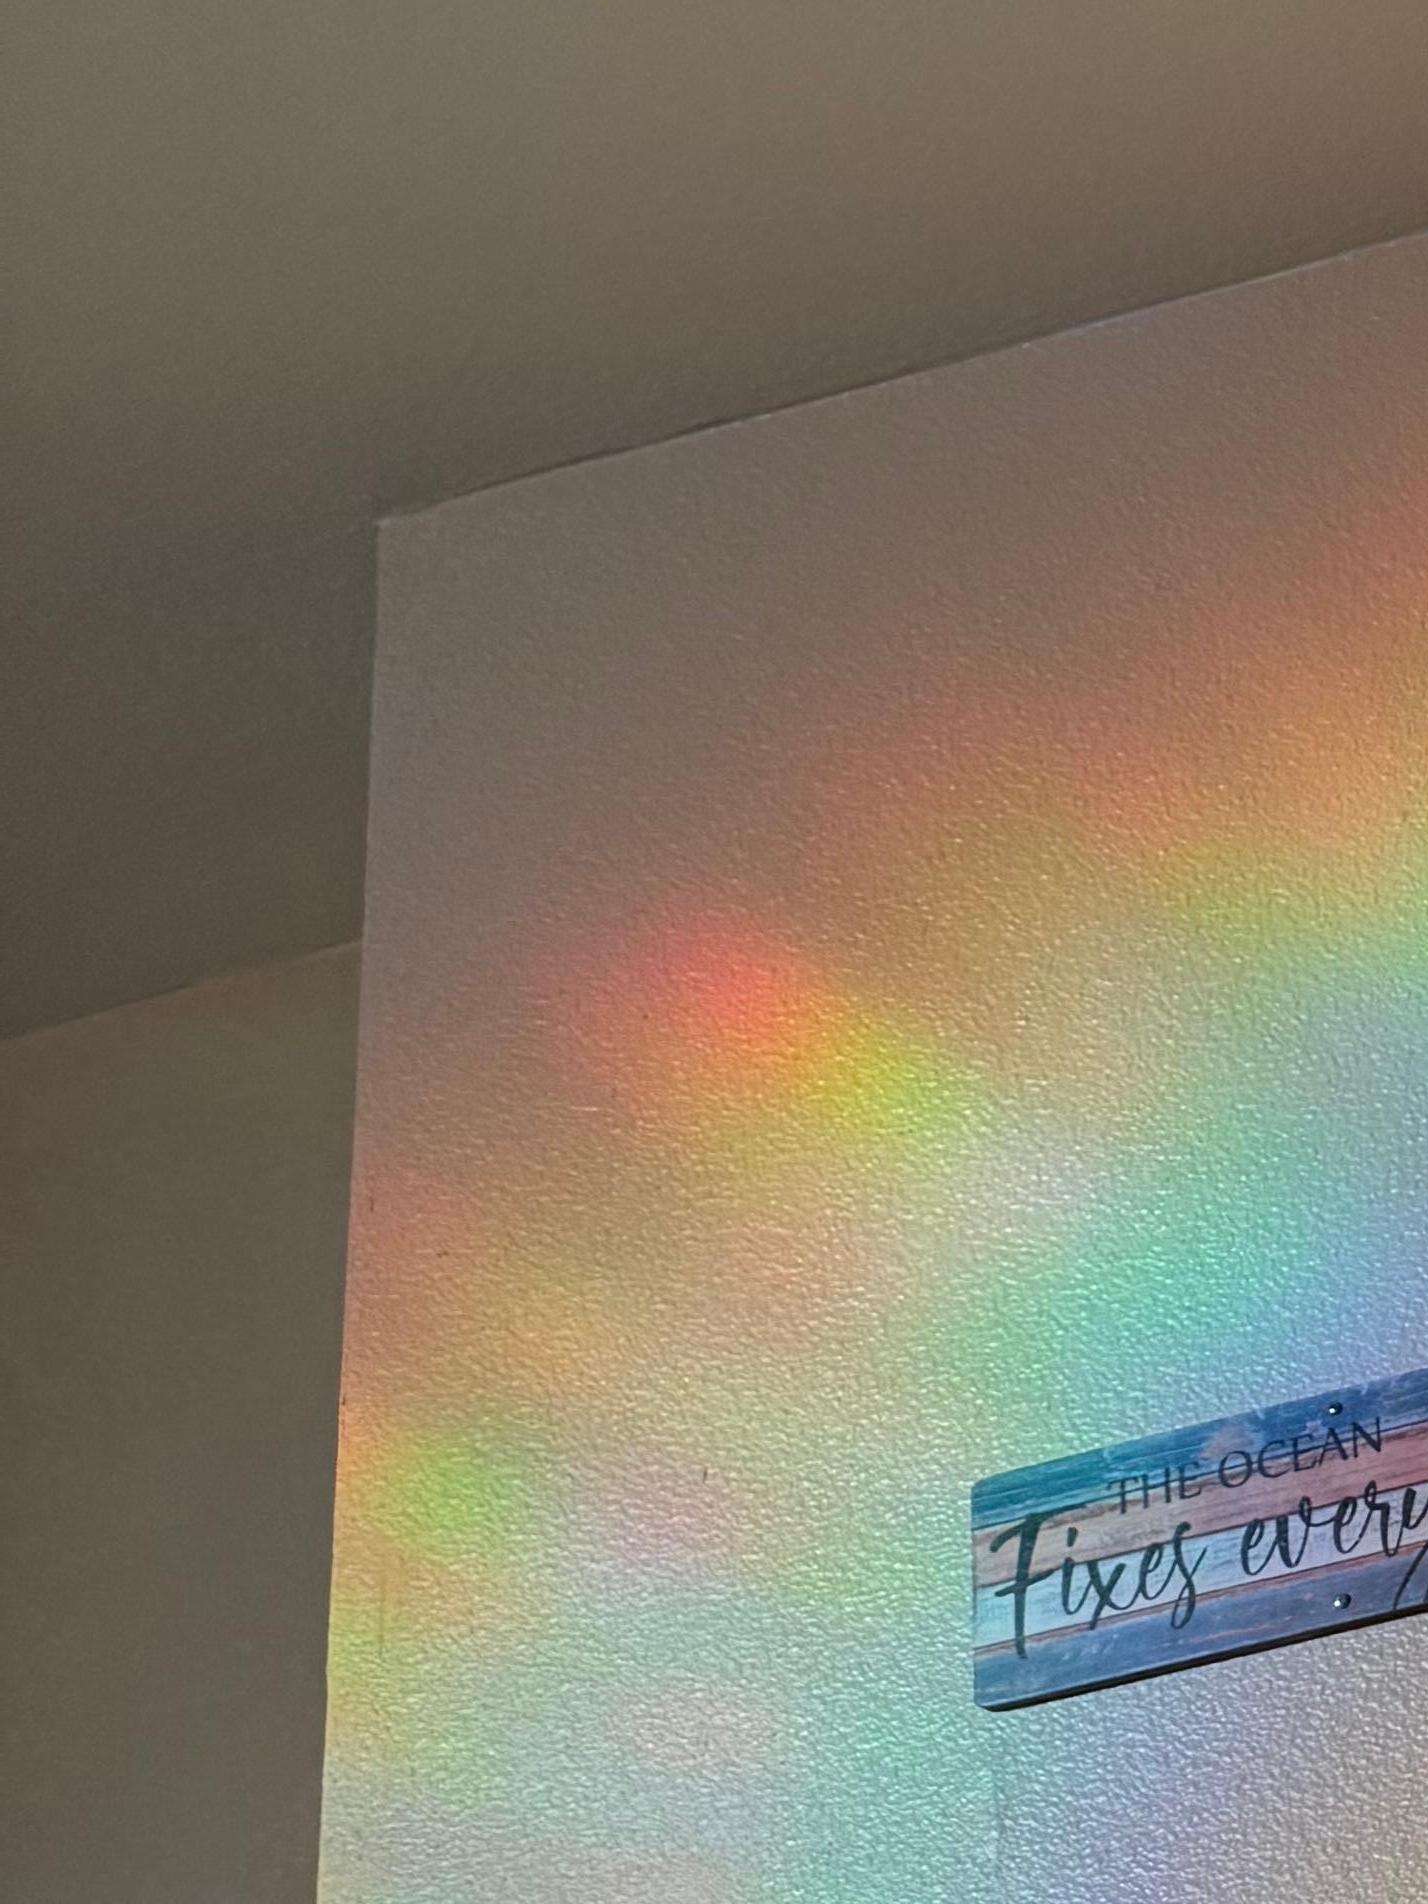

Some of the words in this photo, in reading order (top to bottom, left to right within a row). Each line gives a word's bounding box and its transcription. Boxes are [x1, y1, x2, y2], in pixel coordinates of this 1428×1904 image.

[1108, 1474, 1202, 1513] THE
[1218, 1416, 1383, 1487] OCEAN
[992, 1513, 1206, 1658] Fixes
